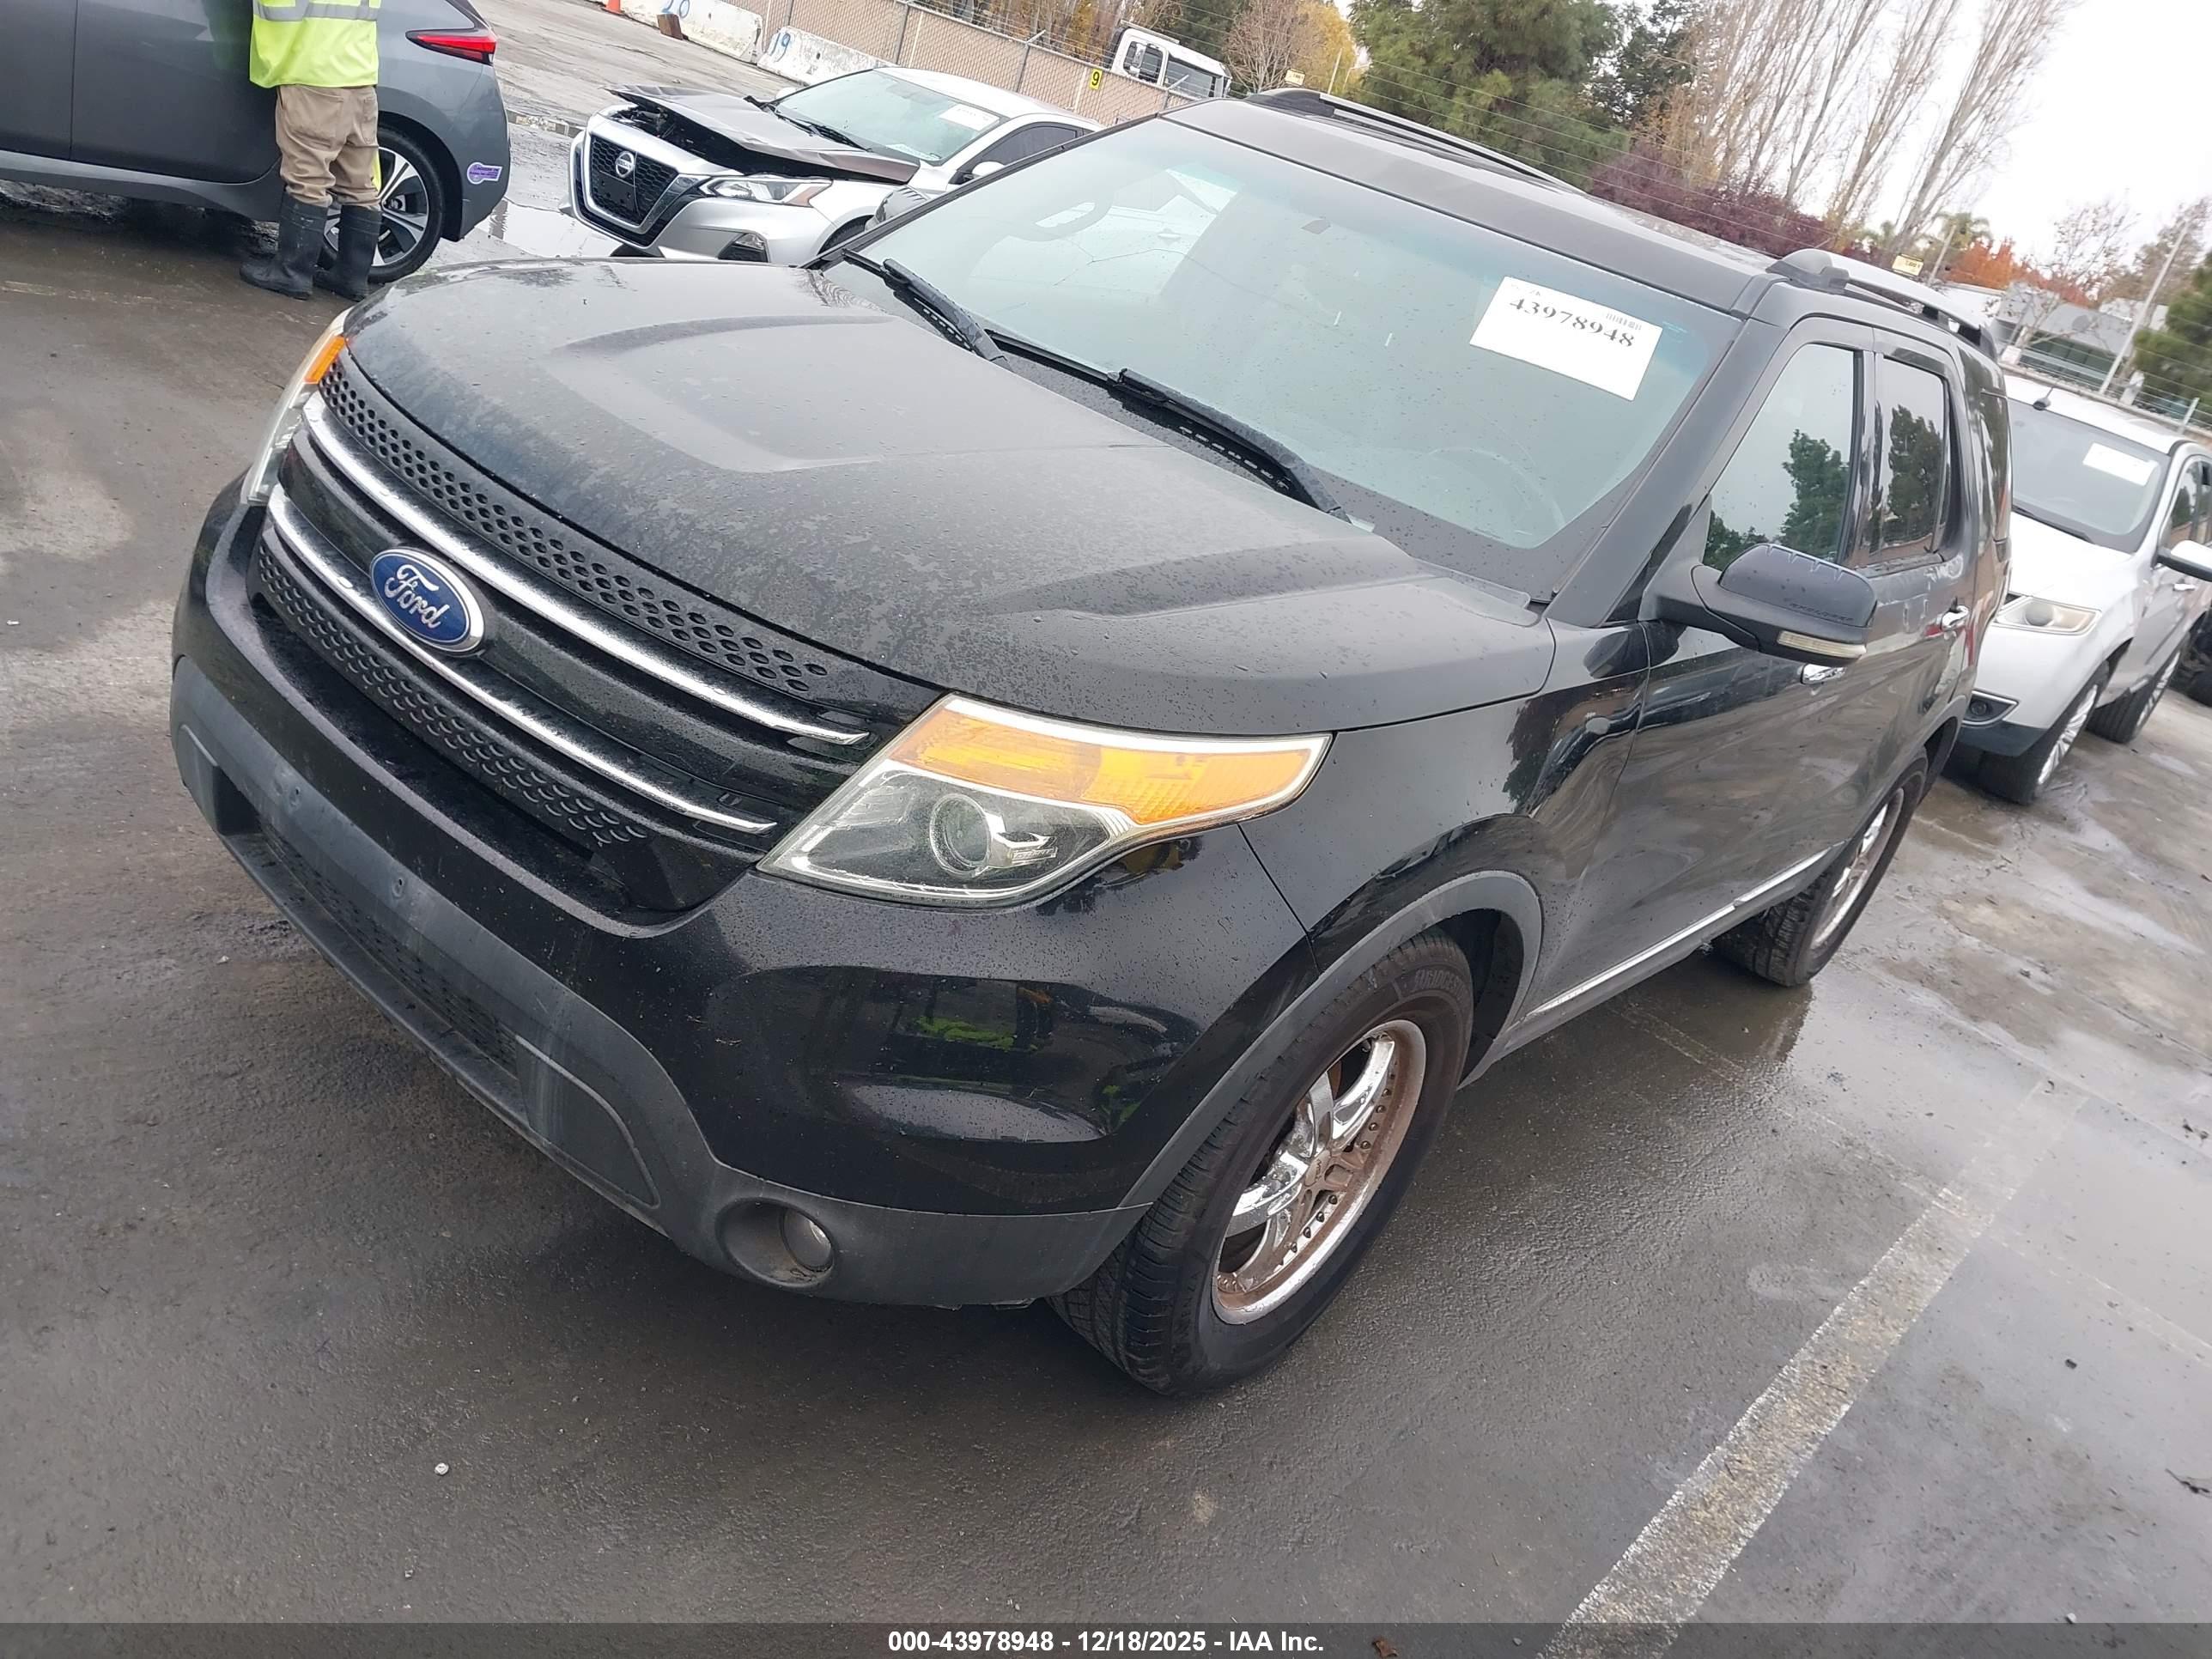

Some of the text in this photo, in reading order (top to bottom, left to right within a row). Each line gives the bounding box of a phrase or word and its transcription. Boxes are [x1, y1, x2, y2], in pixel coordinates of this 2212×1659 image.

[769, 33, 791, 63] 19
[1091, 70, 1100, 86] 9
[1509, 298, 1635, 347] 43978948
[384, 563, 450, 629] Ford
